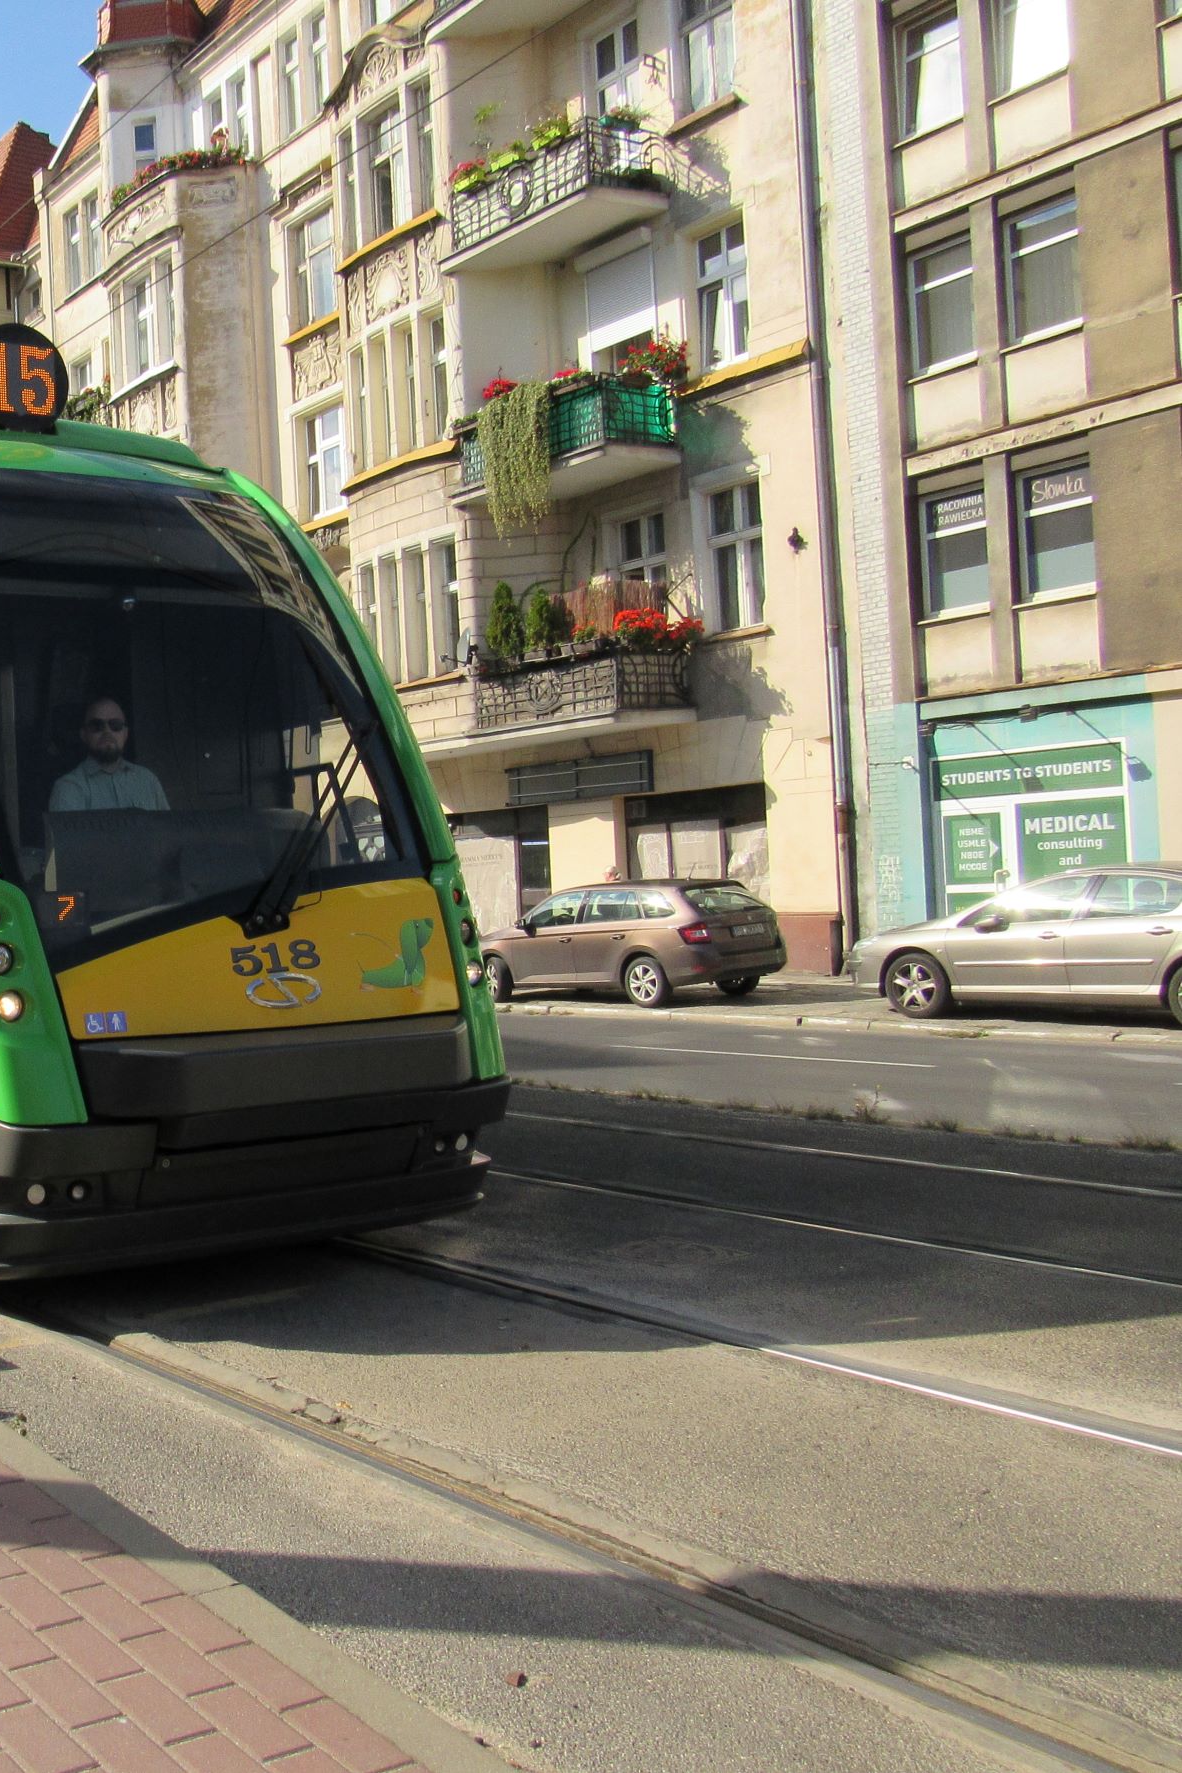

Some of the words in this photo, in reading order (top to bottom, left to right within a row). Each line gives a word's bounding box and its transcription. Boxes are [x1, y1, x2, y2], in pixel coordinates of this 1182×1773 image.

[941, 768, 1011, 787] STUDENTS
[1013, 768, 1032, 780] TO
[1034, 758, 1112, 778] STUDENTS
[1024, 812, 1115, 835] MEDICAL
[956, 839, 987, 848] USMLE
[1037, 836, 1103, 851] consulting
[1058, 854, 1082, 866] and
[57, 896, 75, 921] 7
[230, 939, 321, 976] 518
